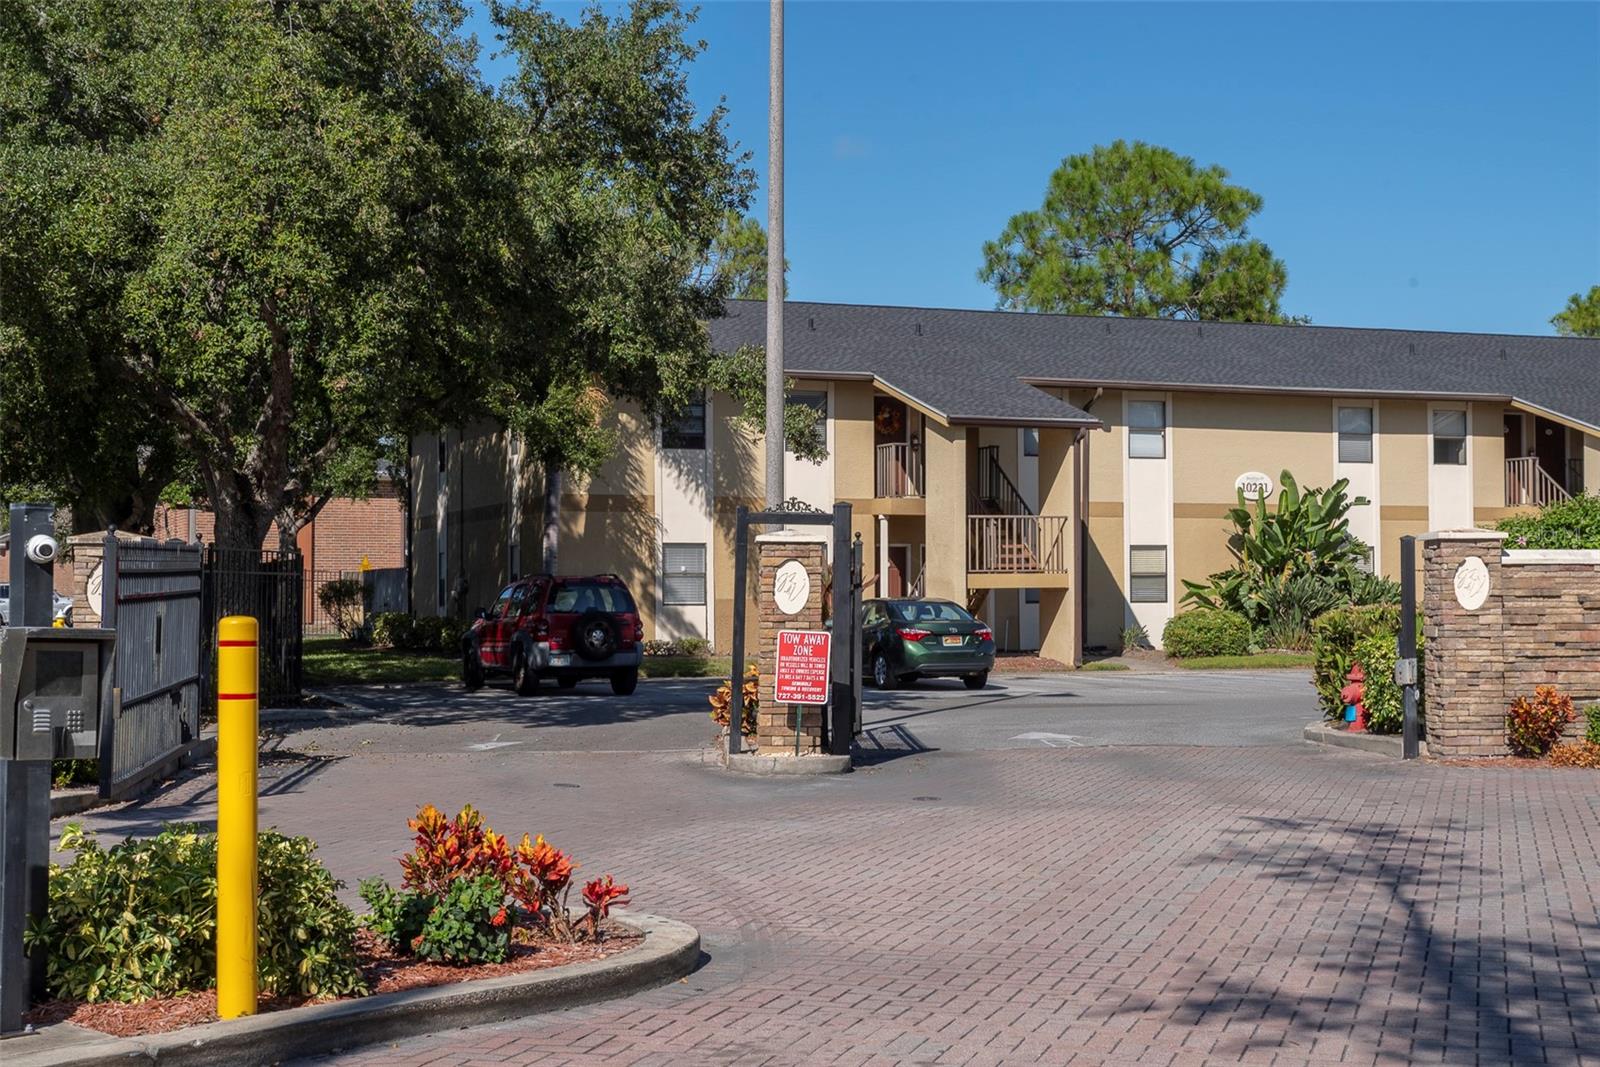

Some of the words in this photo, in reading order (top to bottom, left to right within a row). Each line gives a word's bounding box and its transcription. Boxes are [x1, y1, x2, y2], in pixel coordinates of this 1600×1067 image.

[783, 633, 800, 644] TOW
[804, 634, 825, 646] AWAY
[793, 645, 814, 656] ZONE
